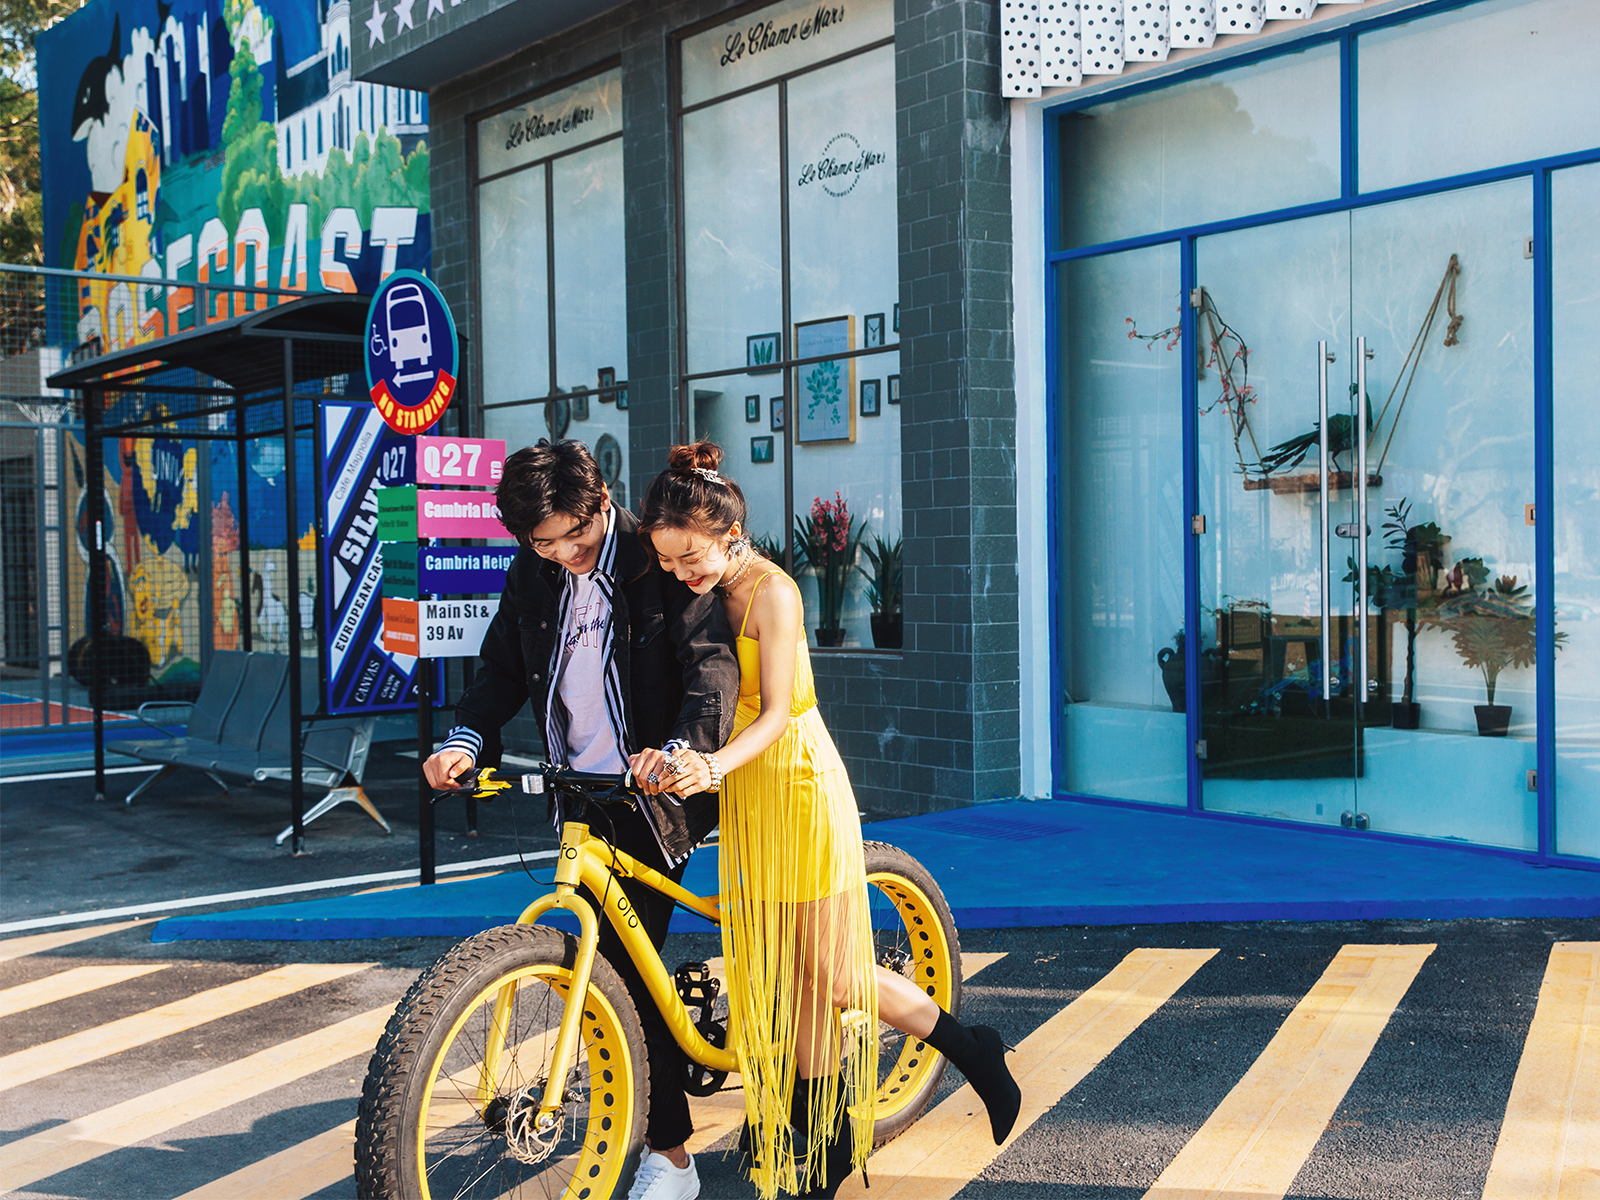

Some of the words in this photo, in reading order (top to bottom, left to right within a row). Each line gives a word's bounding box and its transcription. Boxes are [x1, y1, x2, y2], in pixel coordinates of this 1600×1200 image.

[812, 4, 845, 37] Mars
[378, 392, 395, 418] NO
[396, 380, 450, 429] STANDING
[334, 479, 351, 501] Cafe
[346, 431, 373, 477] Magnolia
[382, 446, 407, 481] Q27
[424, 443, 482, 478] Q27
[424, 501, 481, 519] Cambria
[425, 554, 480, 571] Cambria
[335, 581, 375, 652] EUROPEAN
[426, 604, 462, 620] Main
[464, 603, 478, 619] St
[480, 605, 490, 618] &
[426, 625, 445, 641] 39
[447, 626, 464, 640] Av
[355, 659, 381, 703] CANVAS
[380, 673, 396, 698] CALVIN
[388, 679, 402, 700] KLEIN
[560, 842, 578, 860] fo
